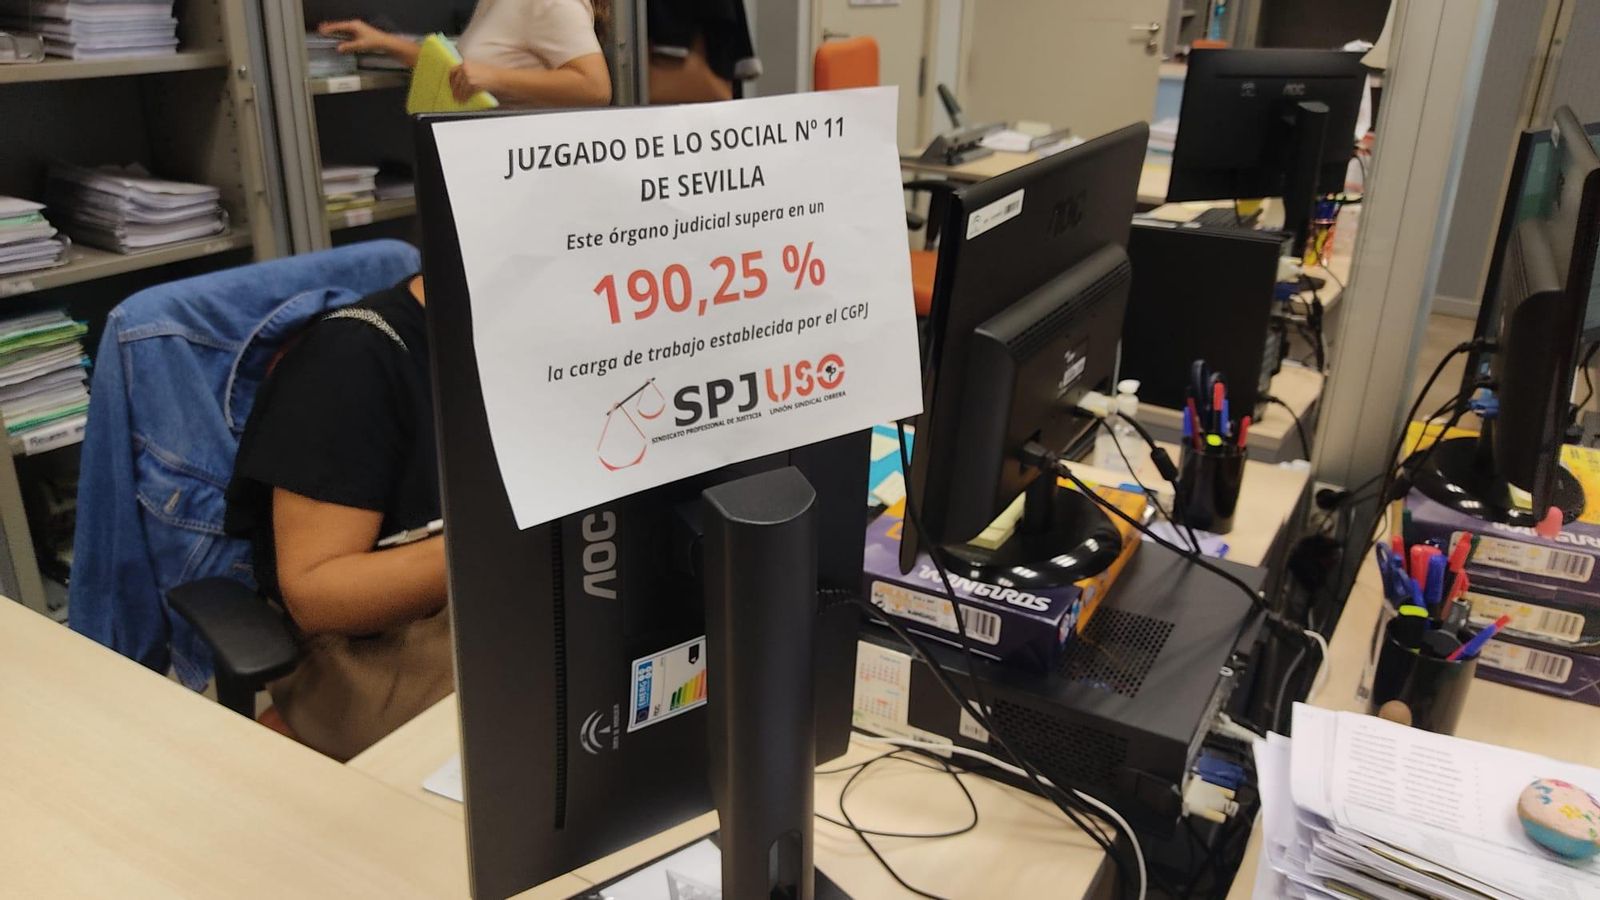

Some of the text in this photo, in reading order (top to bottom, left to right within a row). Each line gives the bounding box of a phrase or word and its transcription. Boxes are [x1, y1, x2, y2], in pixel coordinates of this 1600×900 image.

[503, 116, 845, 181] JUZGADO DE LO SOCIAL Nº 11
[640, 164, 766, 203] DE SEVILLA
[566, 201, 825, 251] Este órgano judicial supera en un
[592, 240, 827, 326] 190,25 %
[547, 301, 870, 383] la carga de trabajo establecida por el CGPJ
[651, 411, 762, 445] SINDICATO PROFESIONAL DE JUSTICIA
[673, 371, 759, 428] SPJ
[769, 390, 847, 416] UNIÓN SINDICAL OBRERA
[581, 509, 617, 600] AOC
